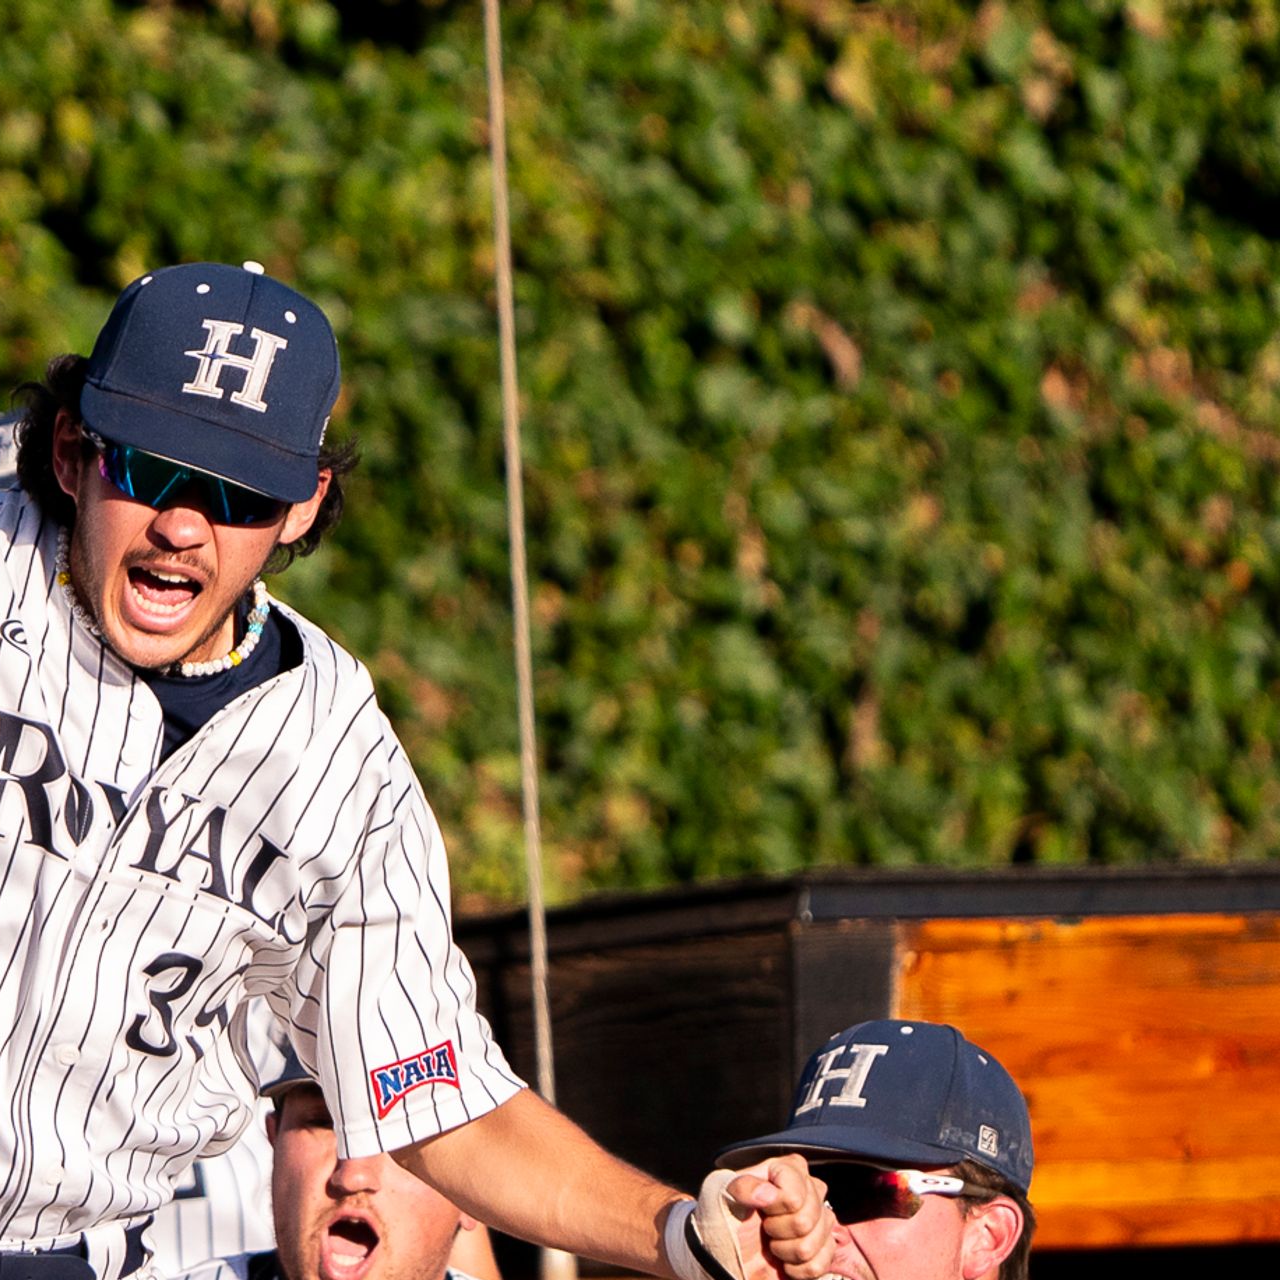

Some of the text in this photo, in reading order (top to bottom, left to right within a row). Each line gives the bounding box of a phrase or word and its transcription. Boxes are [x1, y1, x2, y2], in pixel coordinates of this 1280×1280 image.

[182, 319, 288, 413] H
[375, 1046, 456, 1104] NAIA
[796, 1043, 889, 1116] H
